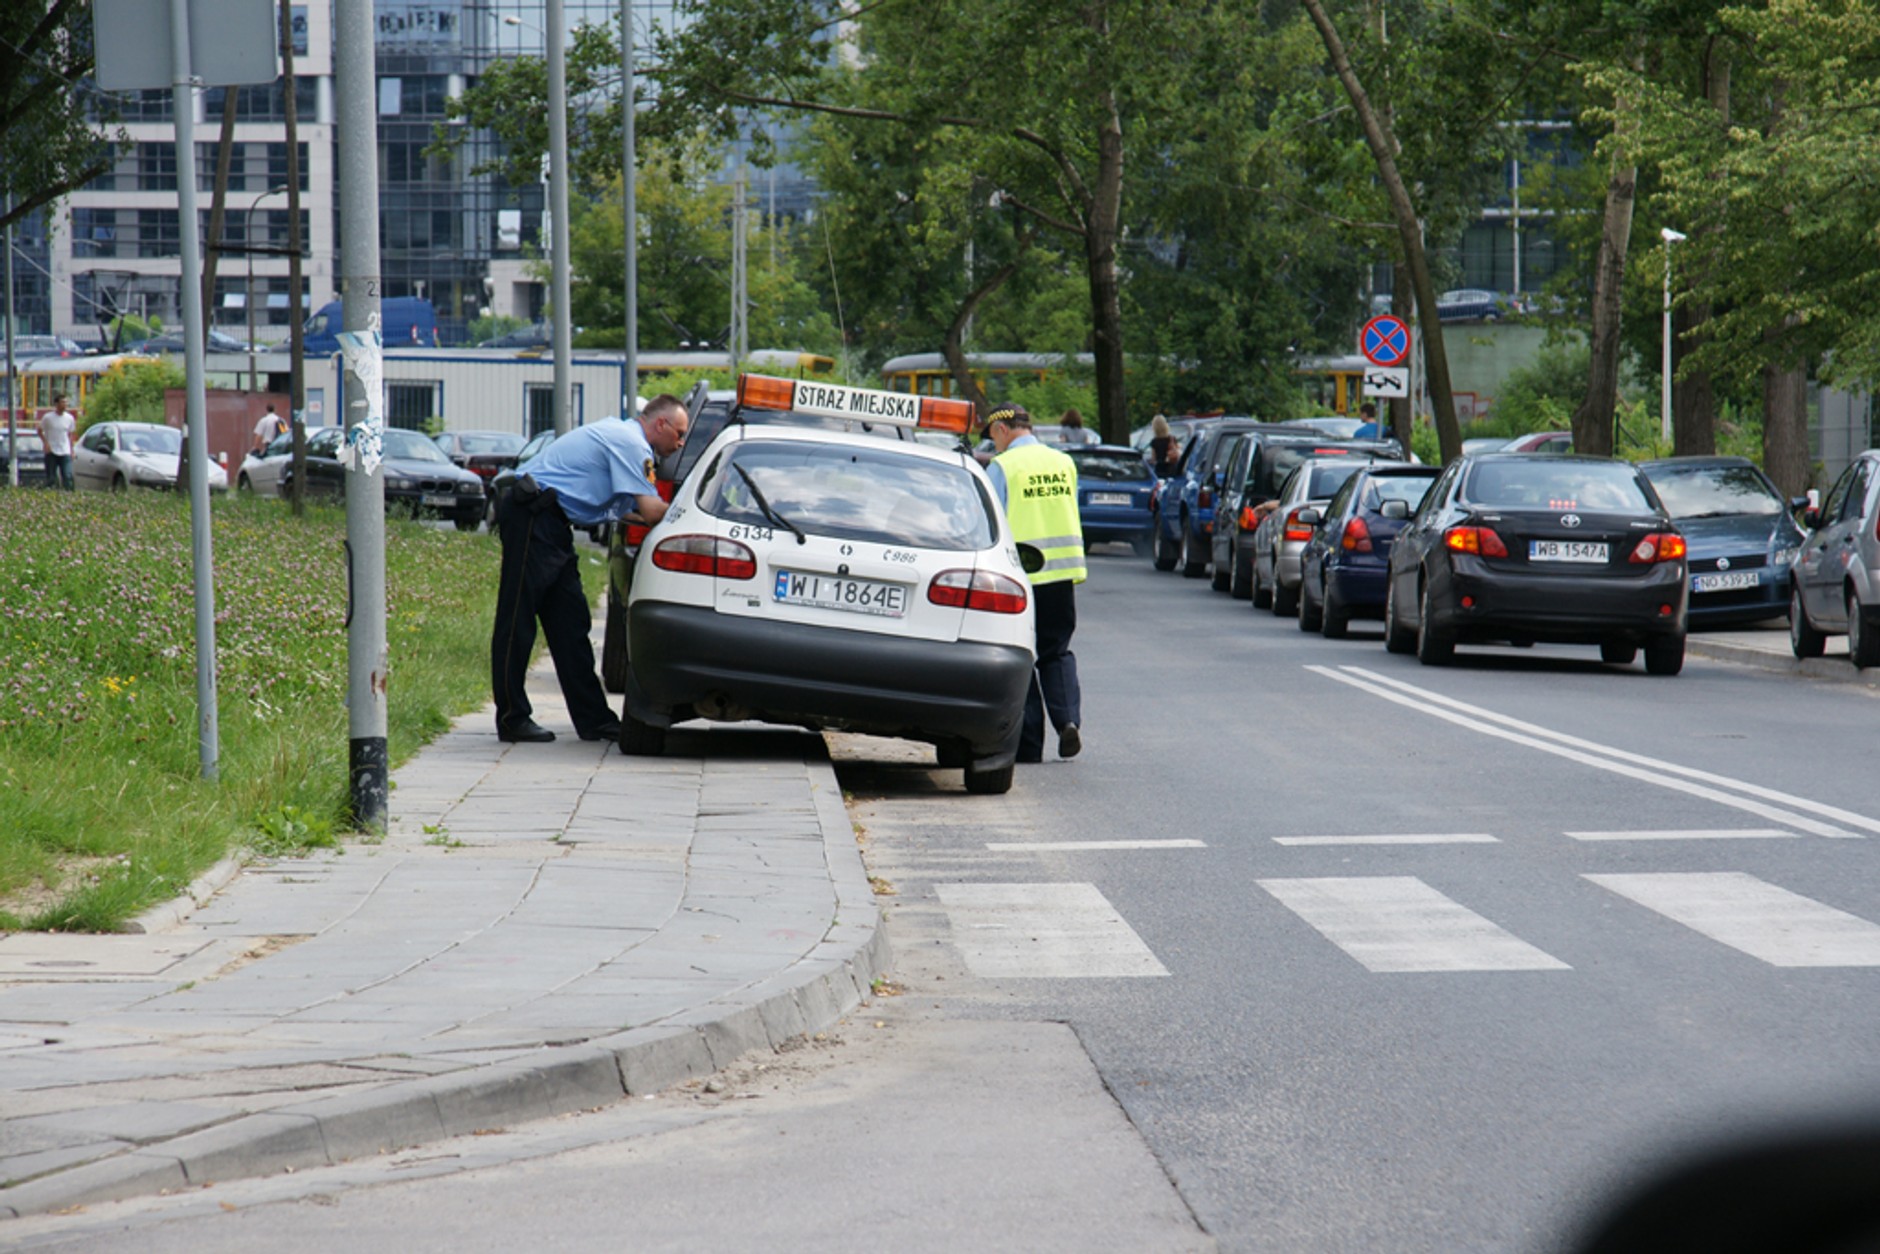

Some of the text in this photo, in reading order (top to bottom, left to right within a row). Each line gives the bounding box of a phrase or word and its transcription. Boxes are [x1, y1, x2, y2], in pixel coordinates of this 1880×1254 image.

[849, 391, 915, 419] MIEJSKA
[1023, 485, 1072, 499] MIEJSKA
[728, 525, 774, 542] 6134
[1538, 542, 1607, 558] WB 1547A
[790, 574, 819, 599] WI
[833, 580, 902, 609] 1864E
